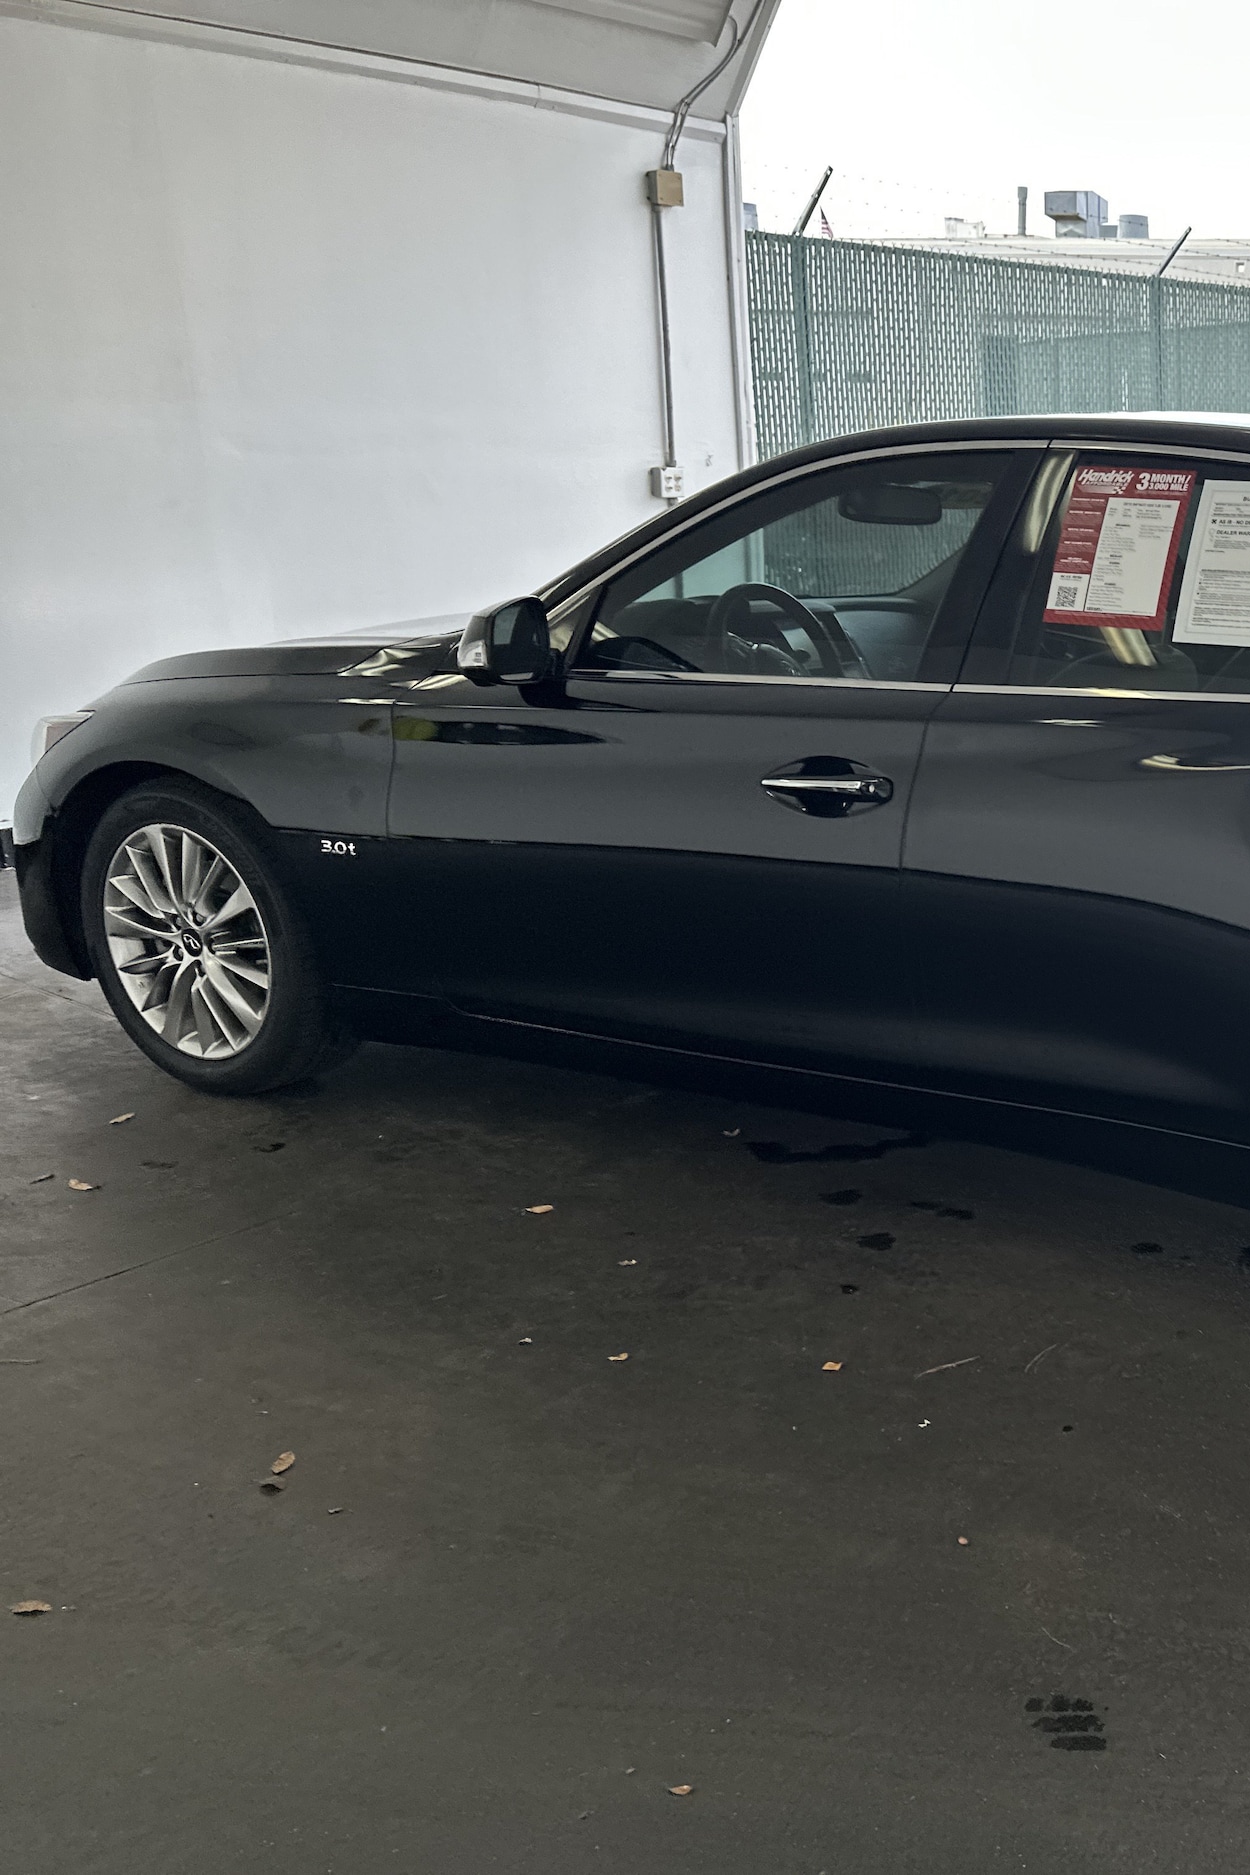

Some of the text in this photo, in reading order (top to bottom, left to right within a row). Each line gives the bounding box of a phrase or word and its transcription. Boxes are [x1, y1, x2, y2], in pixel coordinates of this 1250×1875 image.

[1136, 472, 1192, 491] 3 MONTH/
[1170, 484, 1189, 492] MILE
[321, 839, 356, 856] 3.0t
